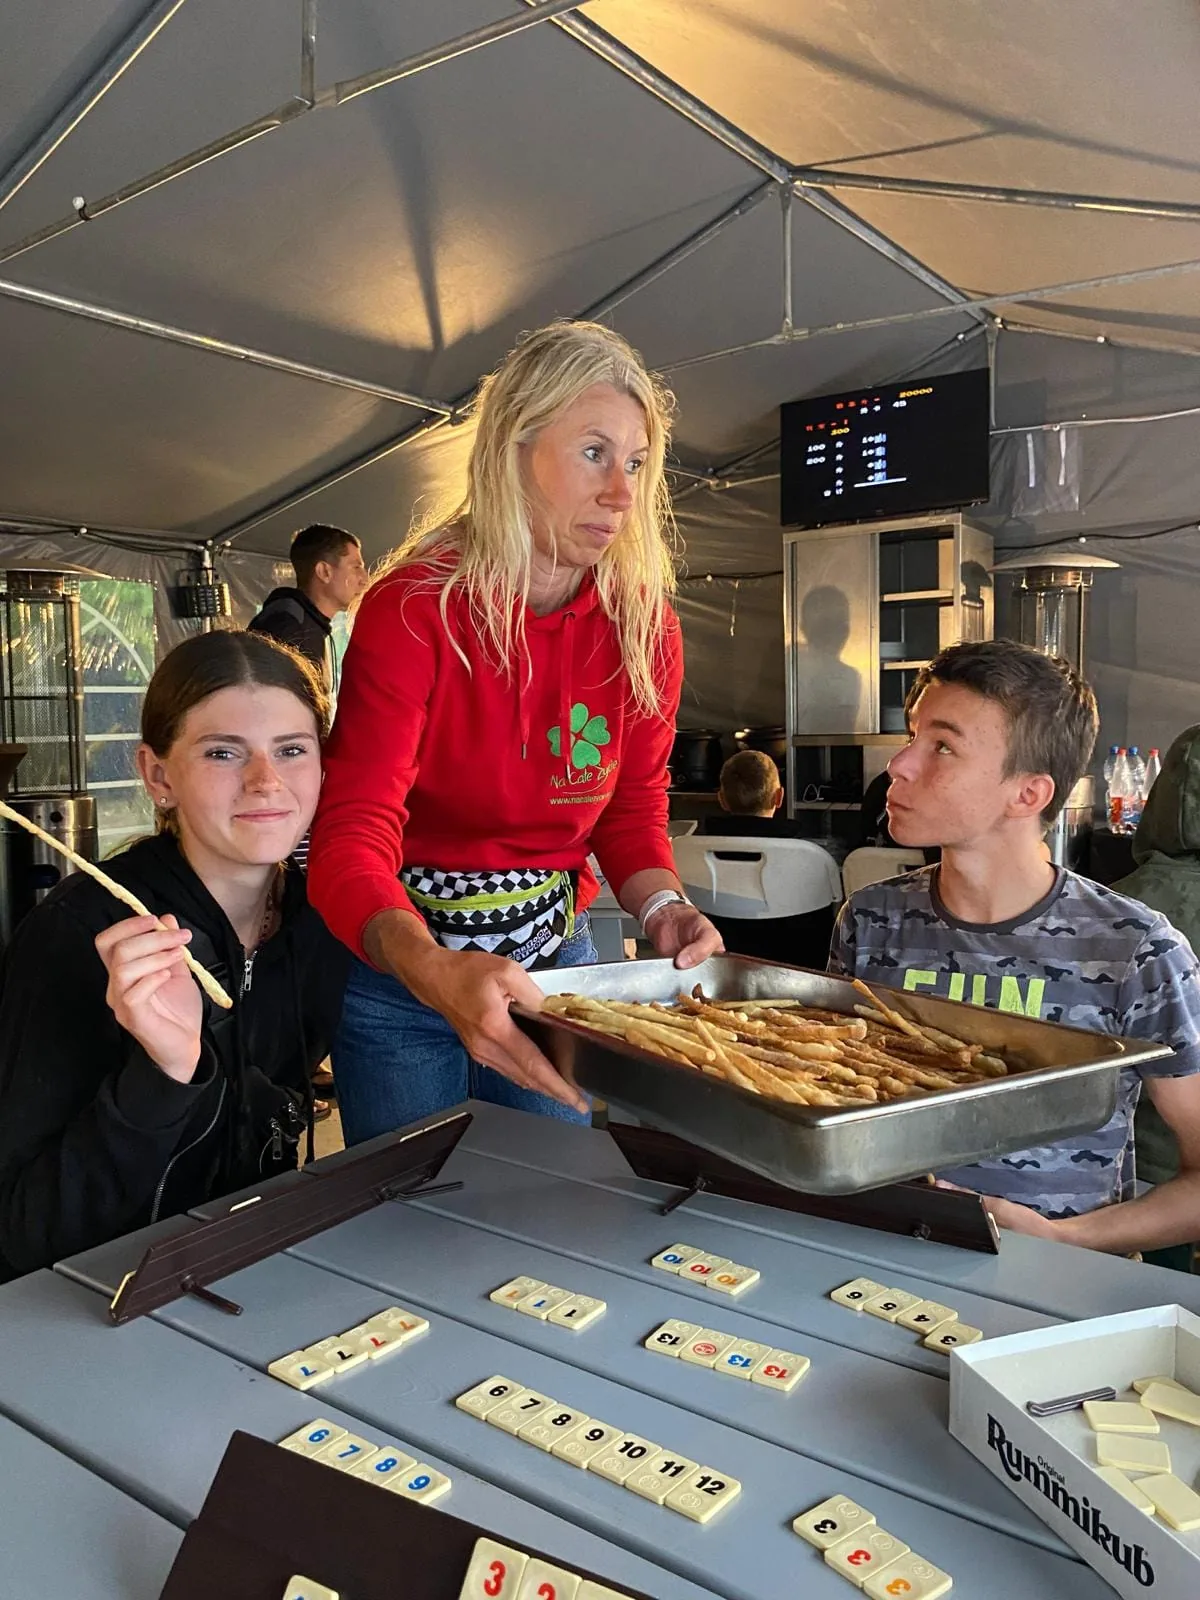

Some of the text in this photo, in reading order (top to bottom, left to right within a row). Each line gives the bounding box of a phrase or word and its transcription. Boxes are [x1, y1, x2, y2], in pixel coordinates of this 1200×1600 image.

[308, 1429, 431, 1490] 6 7 8 9
[489, 1385, 726, 1496] 6 7 8 9 10 11 12
[987, 1413, 1155, 1587] Rummikub
[484, 1560, 506, 1597] 3
[814, 1519, 911, 1595] 3 3 3
